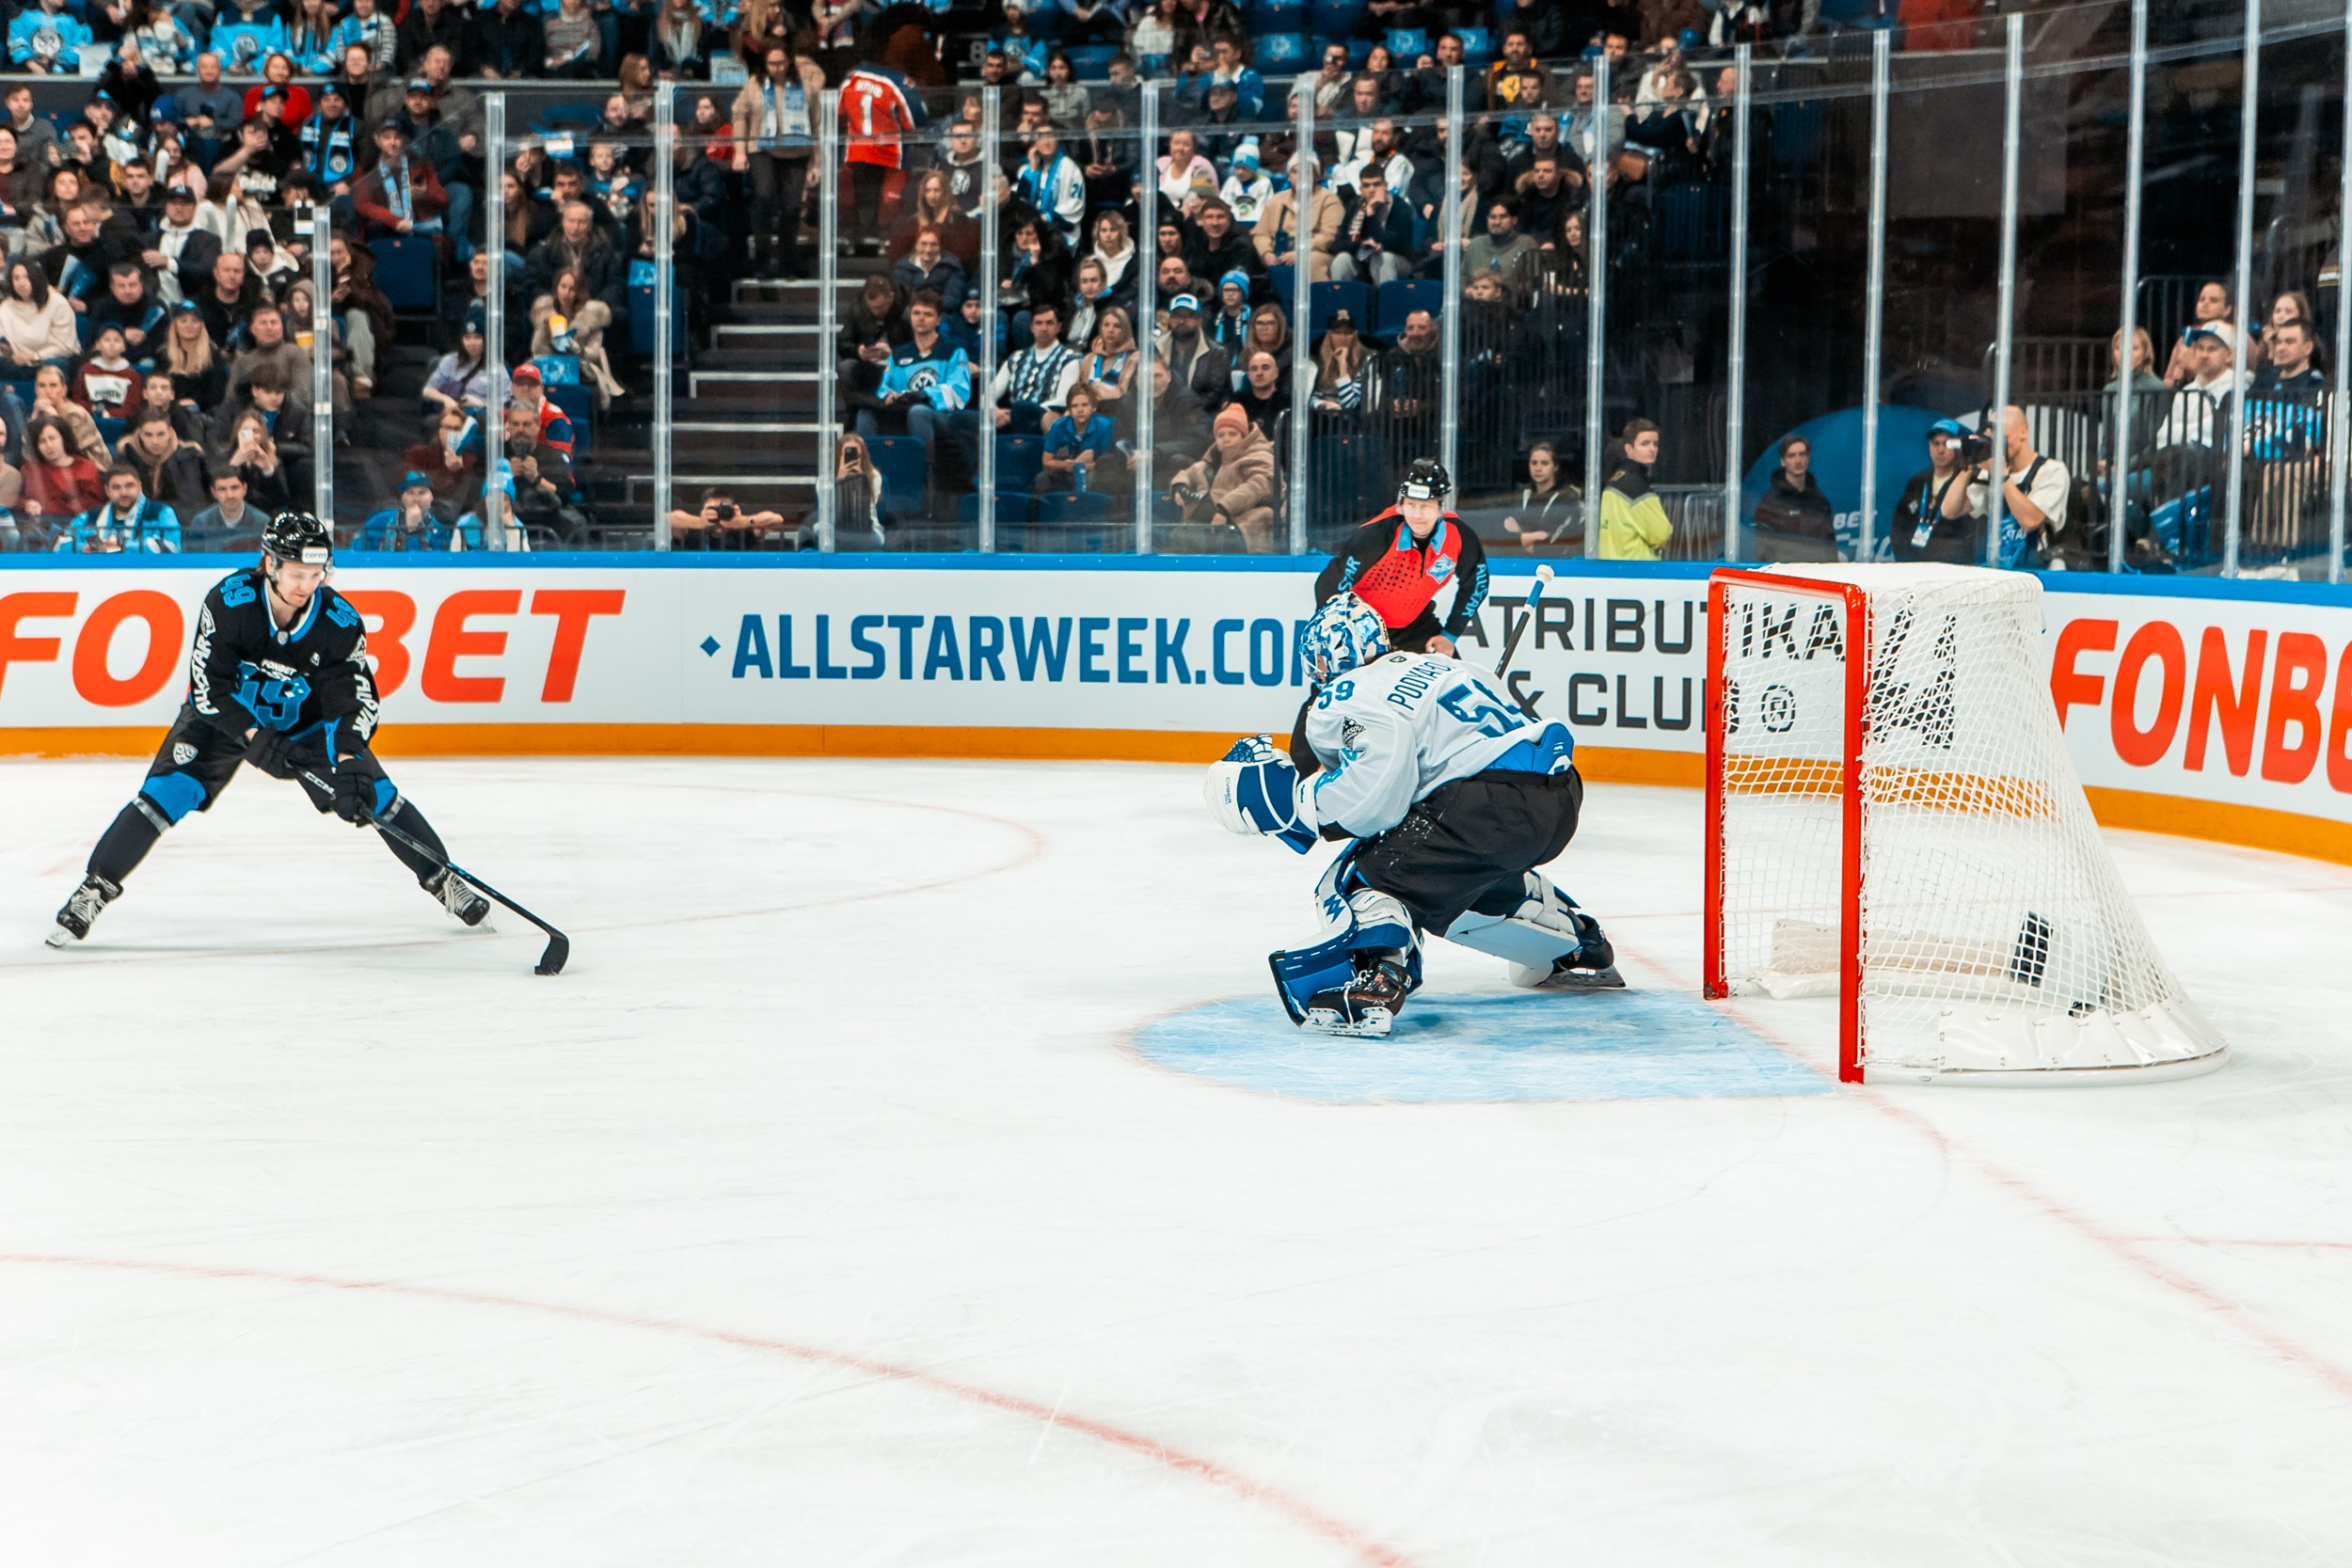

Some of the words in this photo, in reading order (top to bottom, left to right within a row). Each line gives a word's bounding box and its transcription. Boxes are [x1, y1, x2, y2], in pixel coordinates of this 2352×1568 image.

[861, 94, 873, 136] 1
[220, 573, 257, 608] 49
[326, 597, 360, 628] 49
[1460, 596, 1846, 661] ATRIBUIKA
[0, 590, 627, 707] FOBET
[262, 658, 297, 676] FONBET
[1318, 680, 1356, 710] 59
[304, 770, 335, 795] CCM
